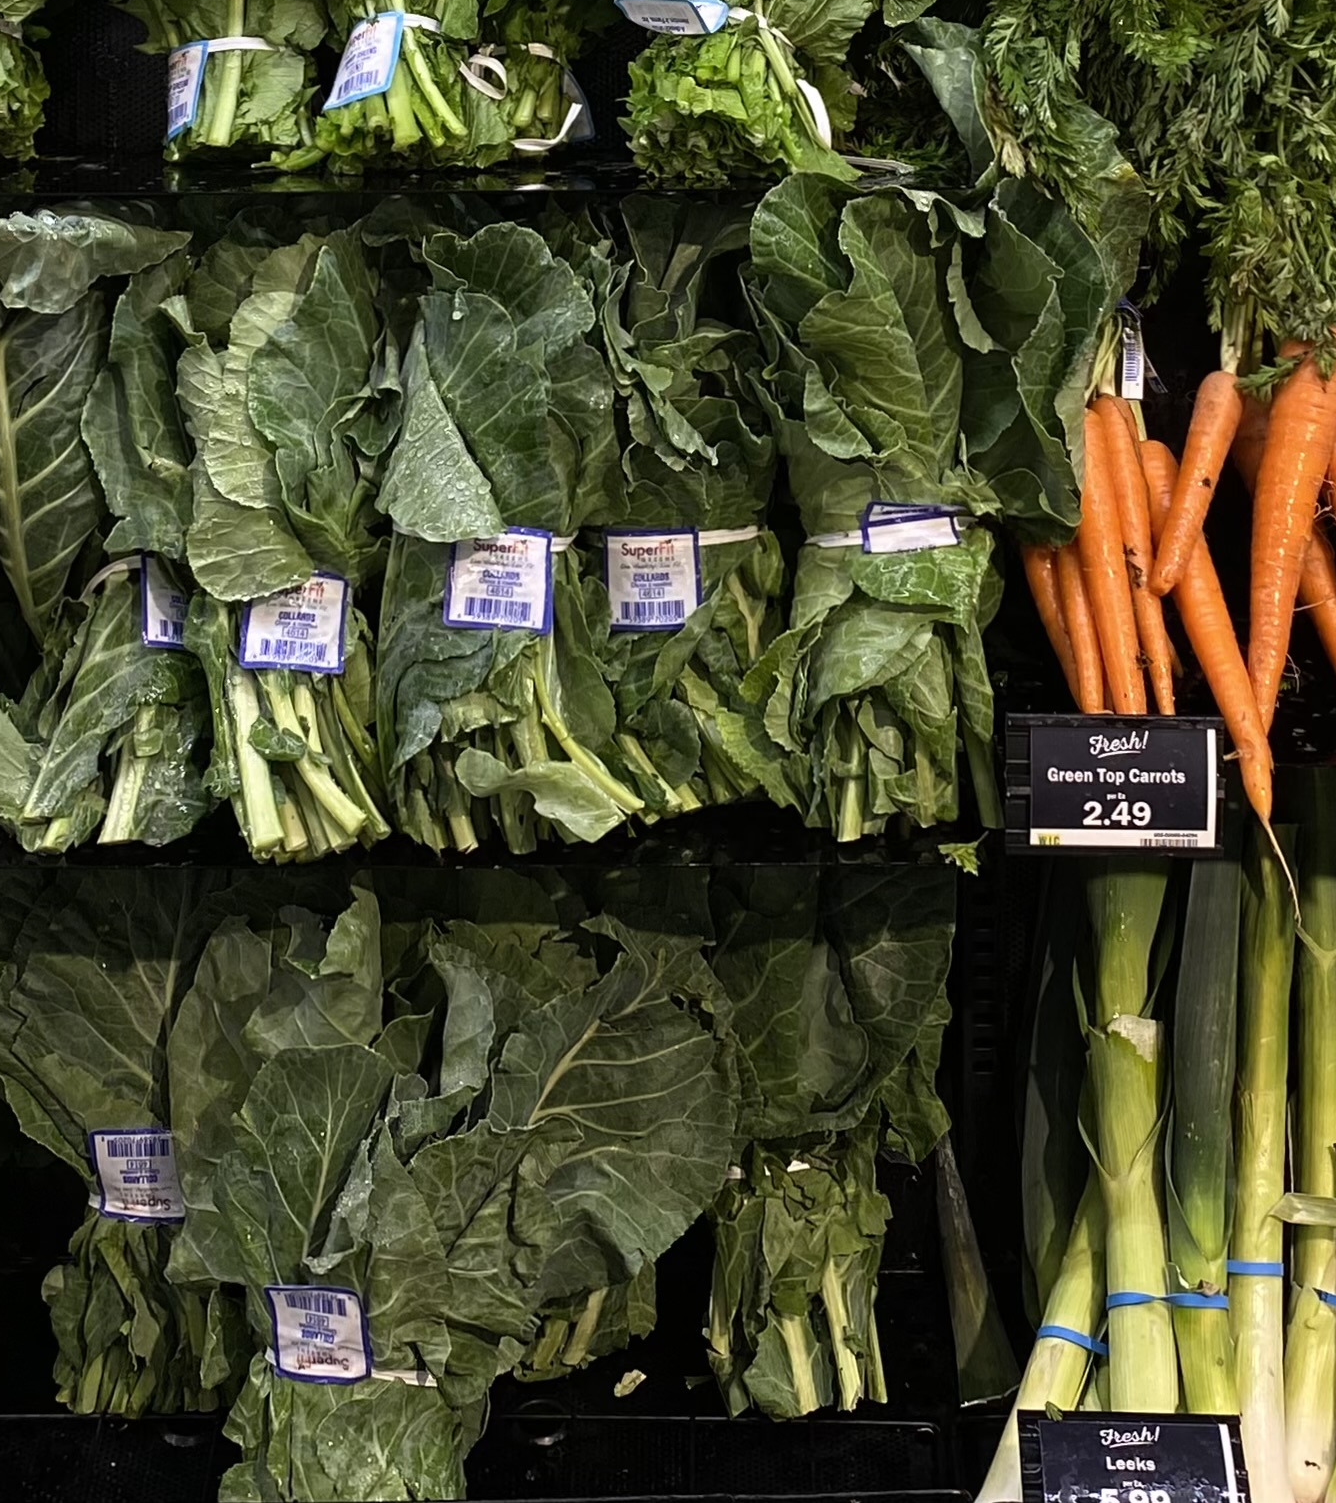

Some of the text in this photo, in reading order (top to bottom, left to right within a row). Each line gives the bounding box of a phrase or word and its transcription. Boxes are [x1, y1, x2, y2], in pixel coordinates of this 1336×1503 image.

[1089, 730, 1149, 755] Fresh!
[1047, 767, 1186, 784] Green Top Carrots
[1082, 800, 1152, 826] 2.49
[1037, 835, 1061, 846] WIC
[1099, 1425, 1161, 1446] Fresh!
[1106, 1456, 1156, 1472] Leeks
